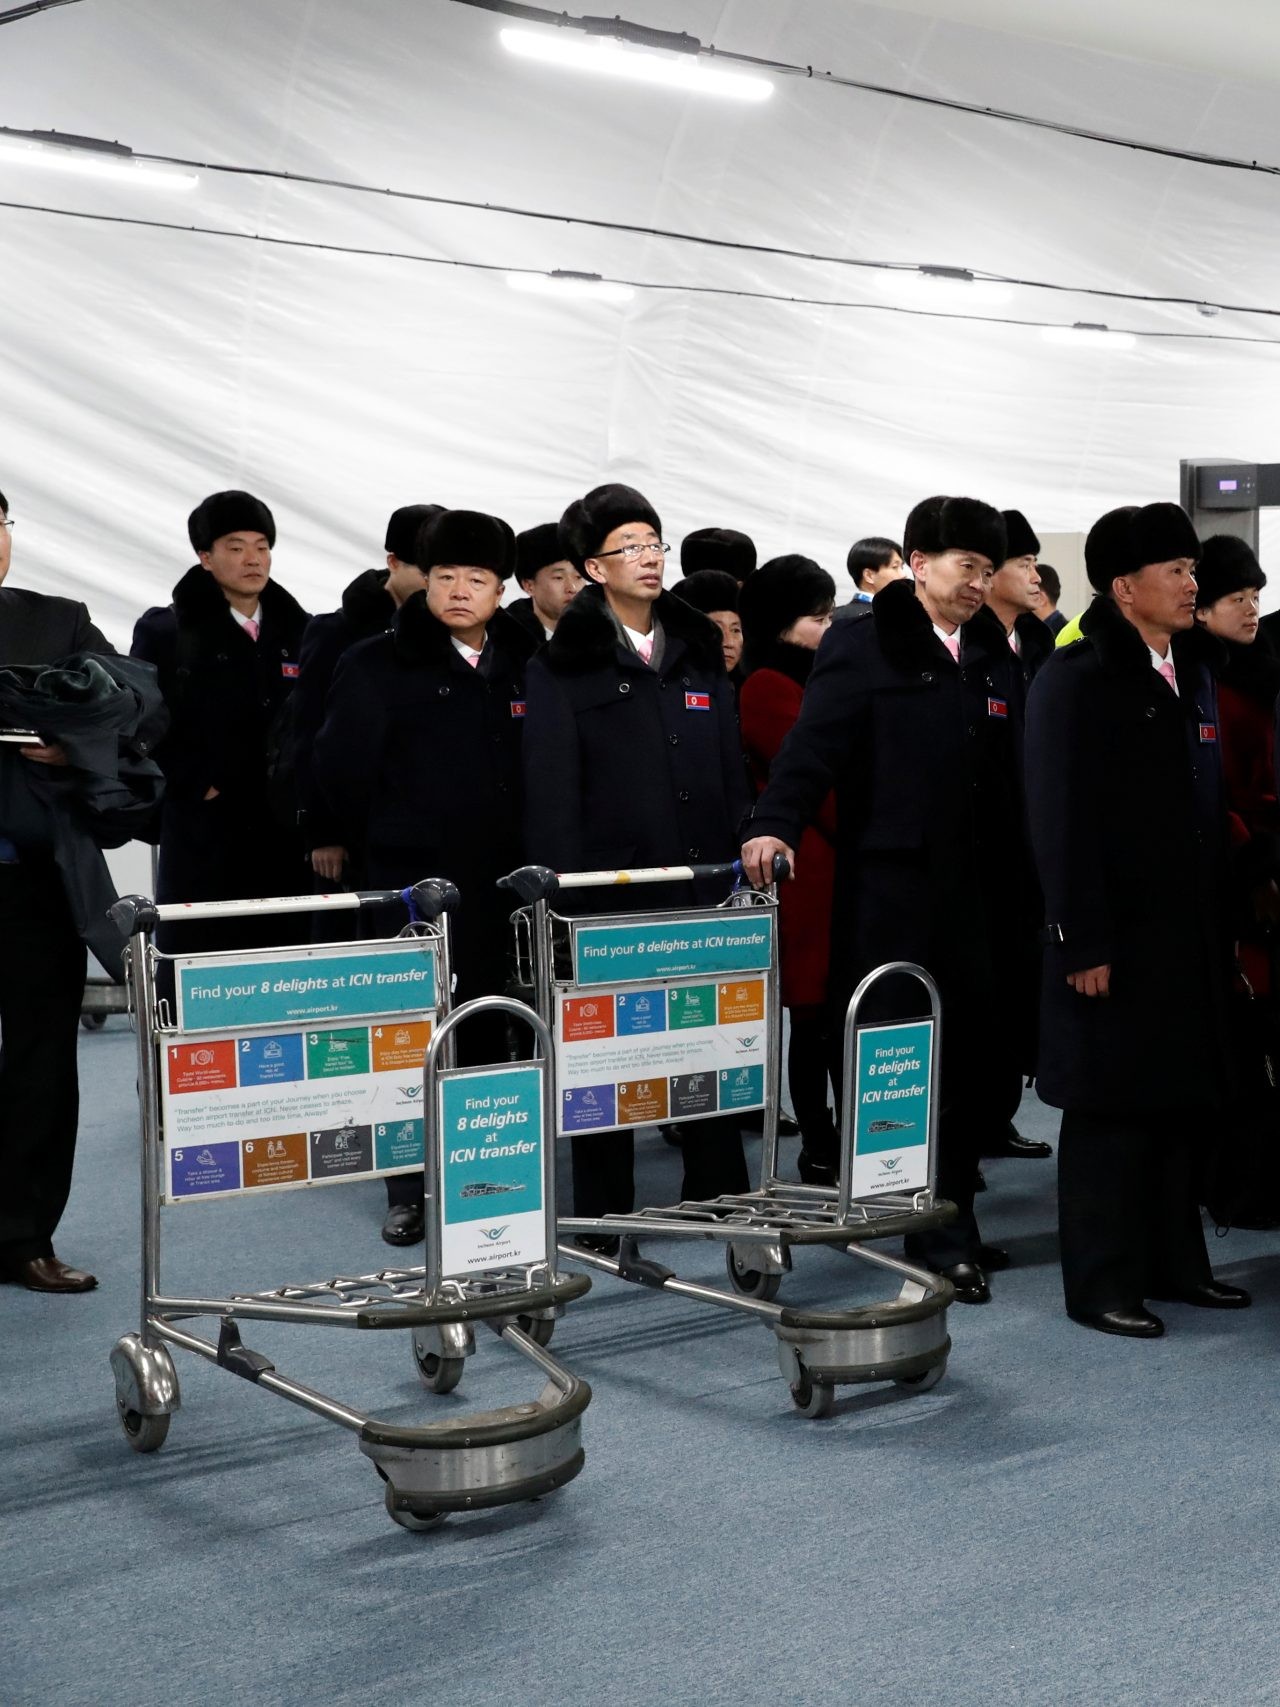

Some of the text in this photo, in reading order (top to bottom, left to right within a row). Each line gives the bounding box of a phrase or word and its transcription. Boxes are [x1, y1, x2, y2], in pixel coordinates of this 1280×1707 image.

[584, 933, 766, 958] Find your 8 delights at ICN transfer
[191, 969, 428, 1000] Find your 8 delights at ICN transfer
[671, 991, 677, 1000] 3
[721, 986, 727, 995] 4
[565, 1002, 570, 1011] 1
[620, 997, 626, 1006] 2
[287, 1005, 339, 1015] www.airport.kr
[375, 1028, 383, 1038] 4
[310, 1034, 318, 1045] 3
[242, 1041, 251, 1052] 2
[171, 1048, 178, 1059] 1
[876, 1046, 915, 1059] Find your
[869, 1060, 920, 1076] 8 delights
[722, 1072, 728, 1081] 8
[673, 1078, 678, 1087] 7
[888, 1077, 897, 1087] at
[620, 1085, 627, 1094] 6
[863, 1085, 925, 1104] ICN transfer
[566, 1092, 572, 1101] 5
[247, 1101, 260, 1109] part
[466, 1095, 519, 1110] Find your
[458, 1111, 528, 1131] 8 delights
[177, 1125, 192, 1133] Way
[378, 1126, 386, 1136] 8
[314, 1134, 321, 1144] 7
[486, 1133, 497, 1143] at
[246, 1142, 254, 1153] 6
[450, 1141, 537, 1163] ICN transfer
[175, 1151, 183, 1161] 5
[870, 1178, 909, 1189] www.airport.kr
[467, 1250, 521, 1264] www.airport.kr
